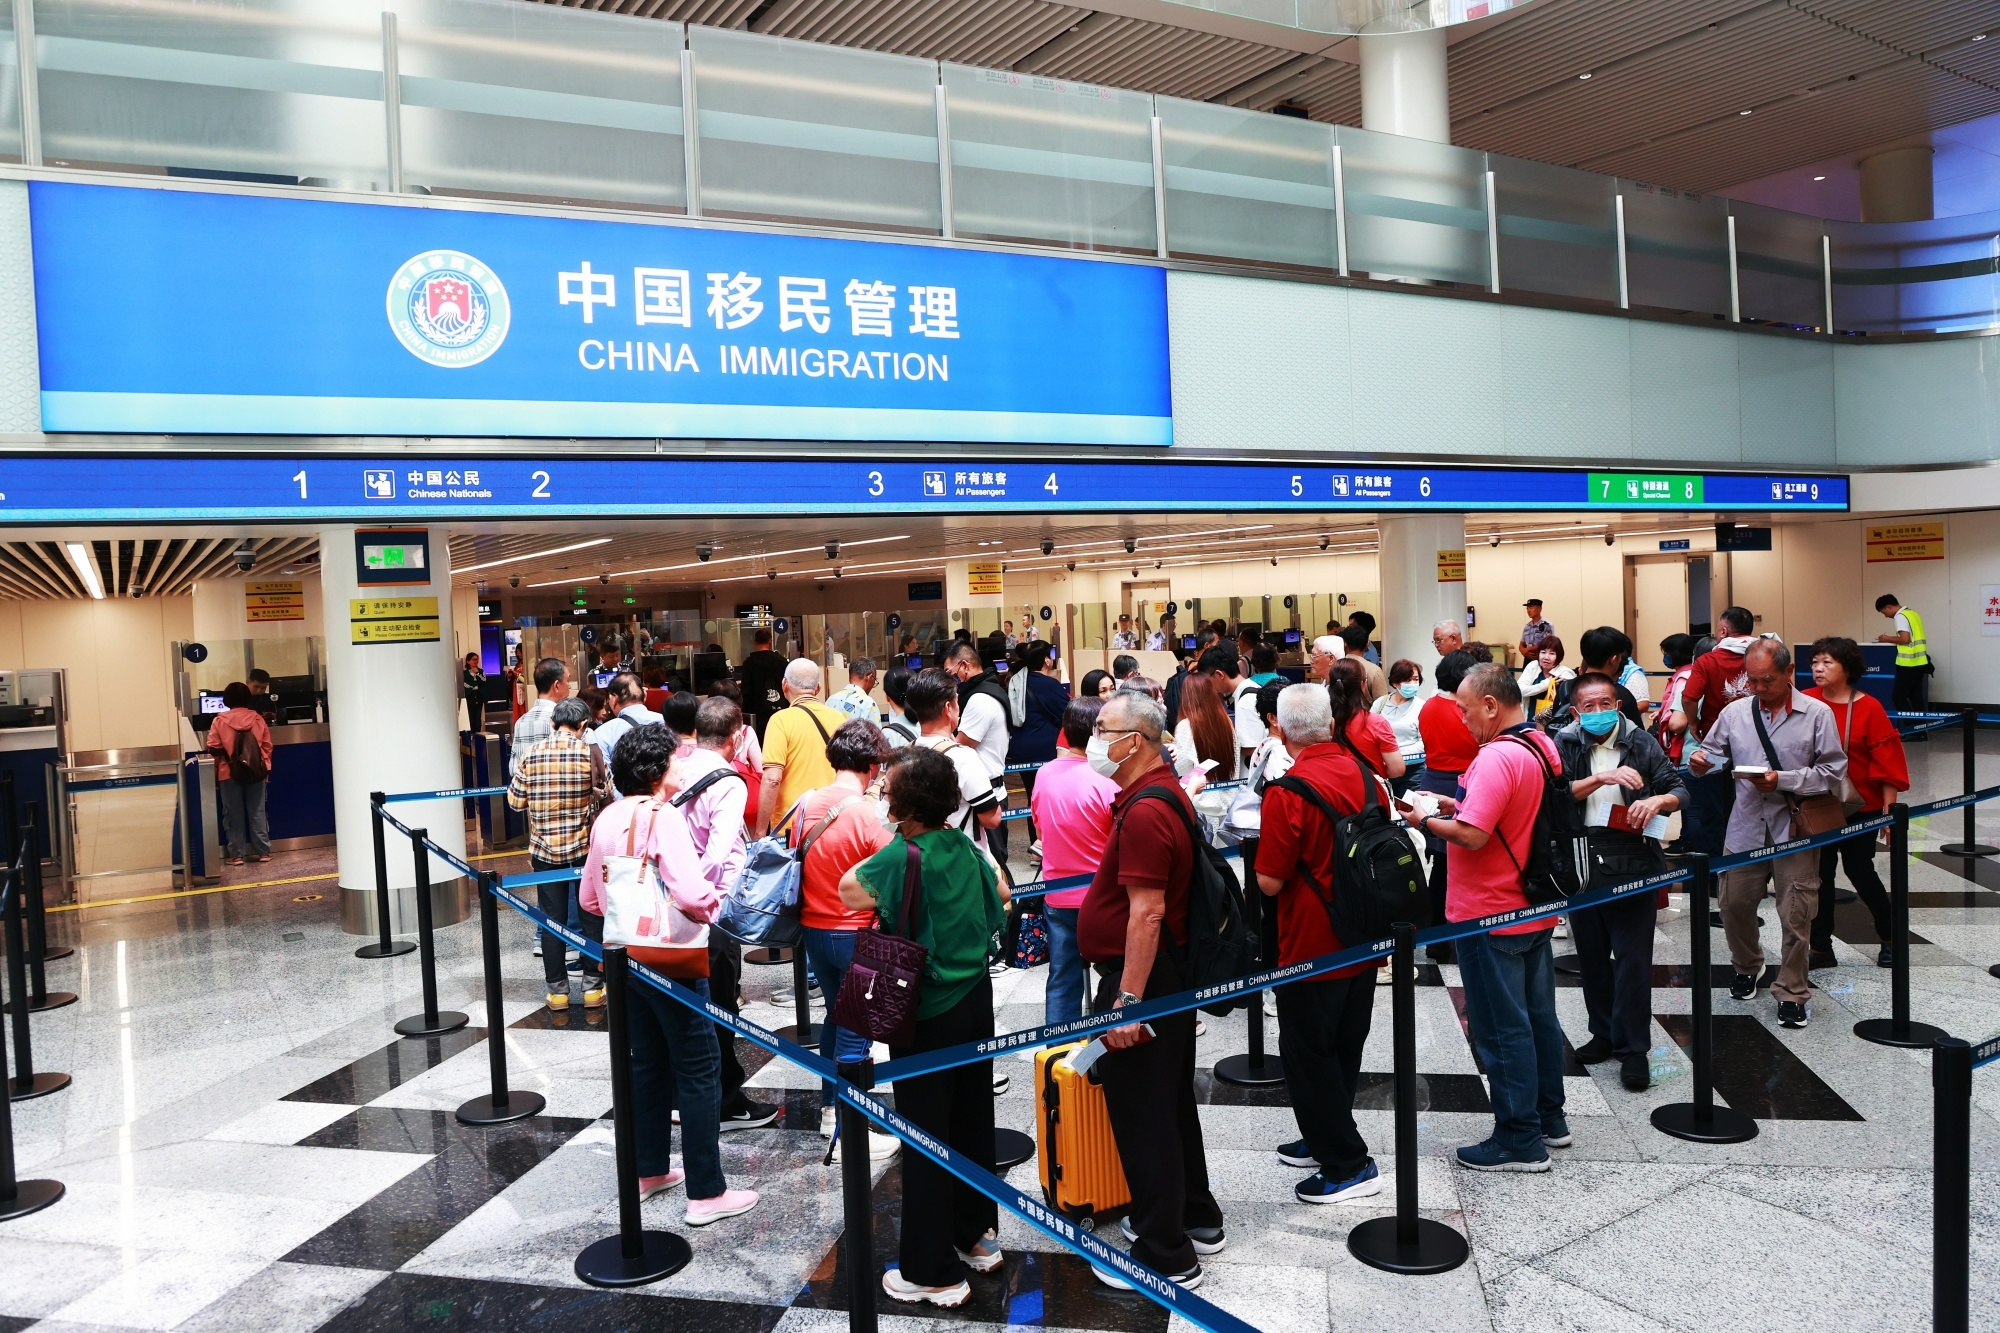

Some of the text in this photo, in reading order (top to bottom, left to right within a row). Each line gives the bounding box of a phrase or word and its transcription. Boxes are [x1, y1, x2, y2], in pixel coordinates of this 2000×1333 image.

[558, 261, 960, 338] 中国移民管理
[398, 320, 500, 360] CHINA IMMIGRATION
[578, 339, 949, 382] CHINA IMMIGRATION
[293, 470, 308, 499] 1
[408, 470, 480, 486] 中国公民
[531, 470, 550, 498] 2
[868, 471, 884, 496] 3
[954, 472, 1007, 485] 所有旅客
[1044, 472, 1059, 495] 4
[1291, 476, 1303, 496] 5
[1354, 476, 1392, 488] 所有旅客
[1420, 476, 1431, 496] 6
[408, 488, 492, 498] Chinese Nationals
[955, 488, 1006, 498] All Passengers
[1601, 480, 1610, 498] 7
[1685, 482, 1694, 498] 8
[1812, 484, 1818, 500] 9
[586, 630, 592, 639] 3
[778, 622, 784, 630] 4
[194, 648, 199, 658] 1
[1750, 846, 1775, 858] 中国移民管理
[1777, 838, 1810, 852] CHINA IMMIGRATION
[1646, 868, 1688, 886] CHINA IMMIGRATION
[1010, 883, 1046, 894] MMIGRATION
[1612, 880, 1643, 895] 中国移民管理
[1519, 900, 1568, 917] CHINA IMMIGRATION
[1479, 911, 1516, 928] 中国移民管理
[1248, 962, 1313, 986] CHINA IMMIGRATION
[1195, 979, 1244, 1000] 中国移民管理
[705, 1002, 733, 1024] 中国移民管理
[735, 1018, 779, 1047] CHINA IMMIGRATION
[1044, 1010, 1123, 1038] CHINA IMMIGRATION
[977, 1030, 1037, 1054] 中国移民管理
[847, 1086, 885, 1119] 中国移民管理
[888, 1112, 949, 1161] CHINA IMMIGRATION
[1017, 1196, 1075, 1241] 中国移民管理
[1081, 1234, 1176, 1301] CHINA IMMIGRATION
